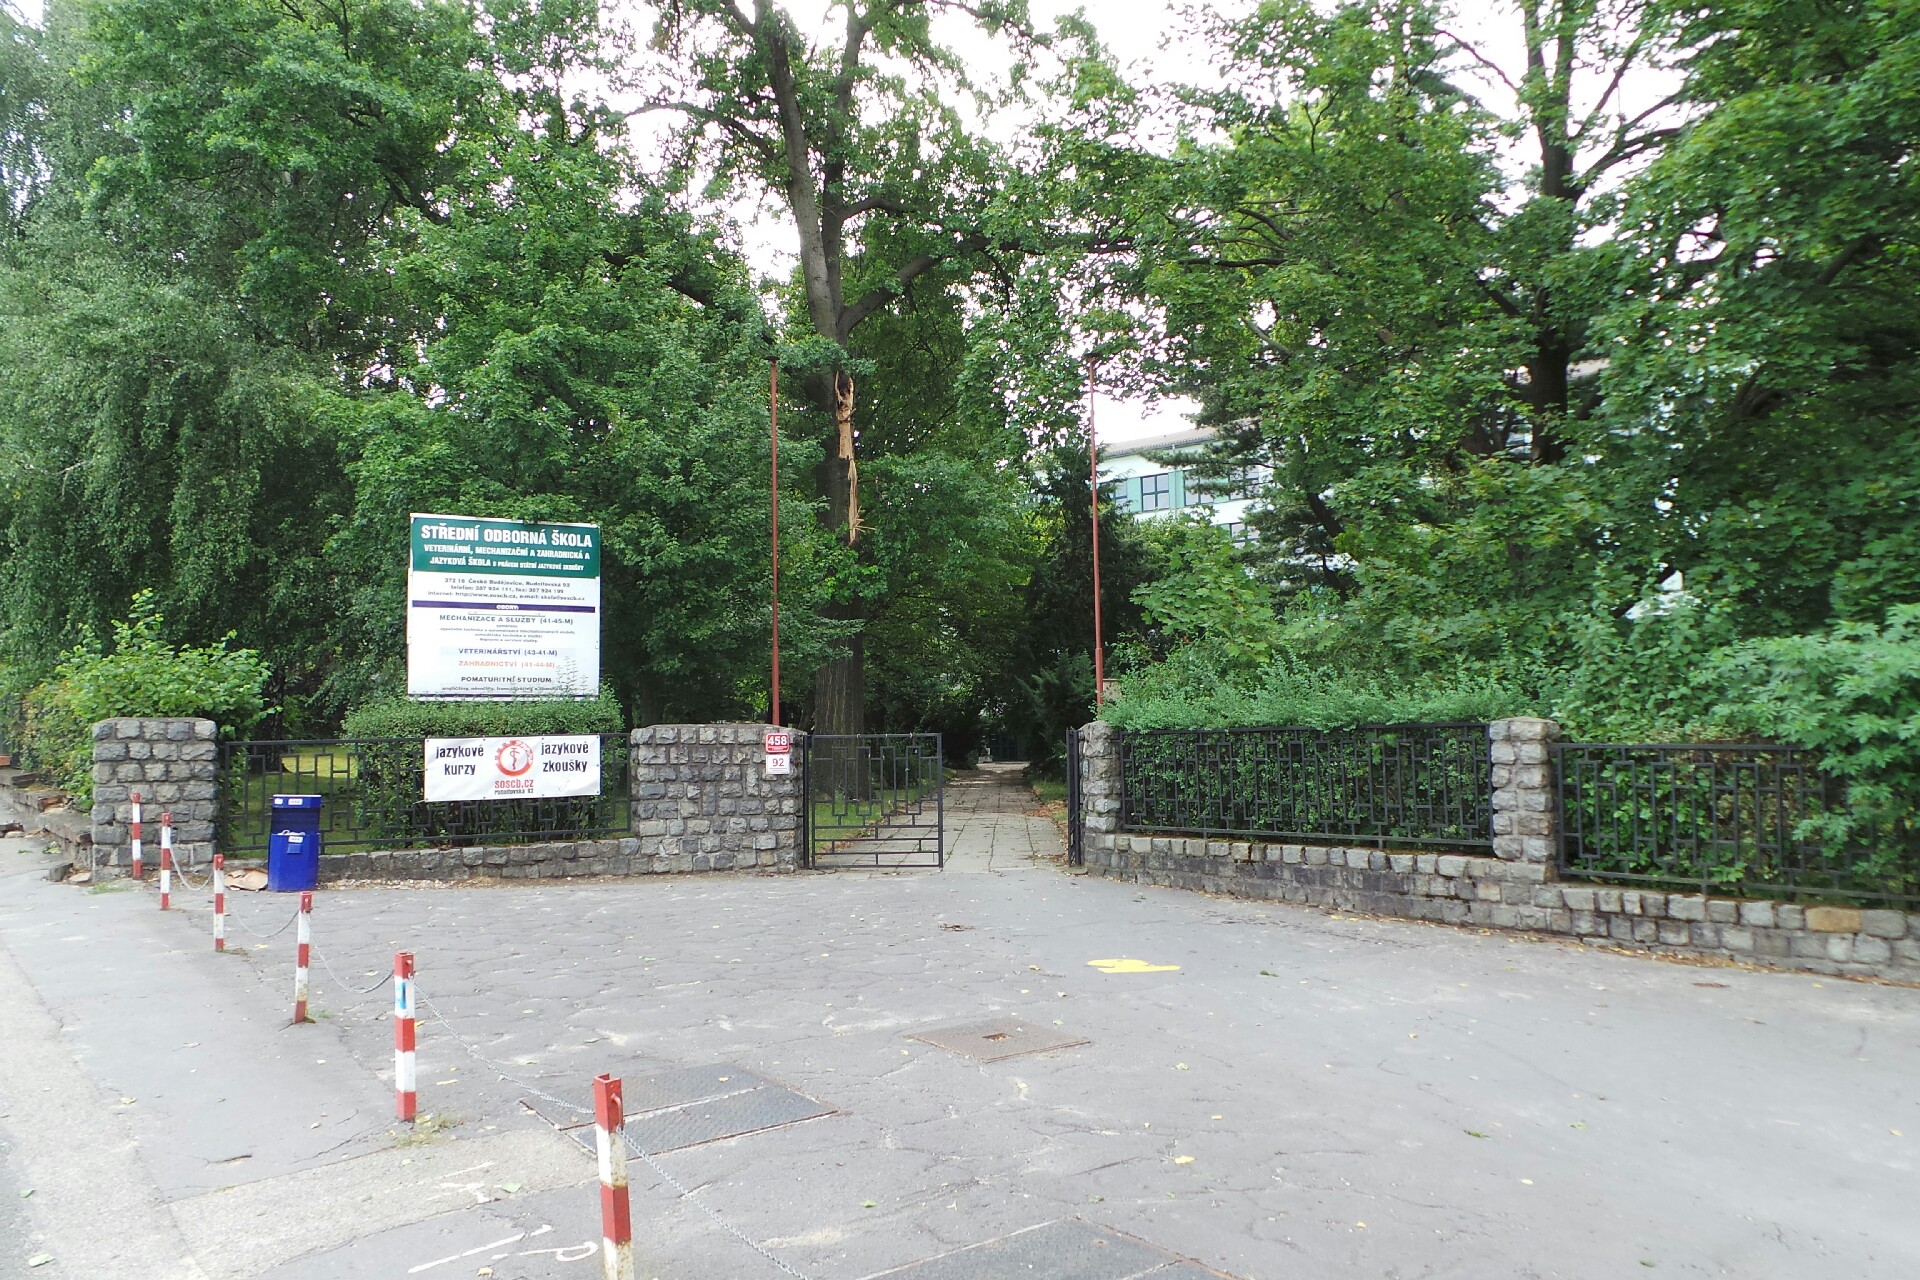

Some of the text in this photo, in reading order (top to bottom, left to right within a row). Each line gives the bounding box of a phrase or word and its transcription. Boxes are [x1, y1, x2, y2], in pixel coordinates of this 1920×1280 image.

[421, 522, 592, 547] STŘEDNÍ ODBORNÁ ŠKOLA
[424, 543, 590, 560] VETERINÁRNÍ, MECHANIZAČNÍ A ZAHRADNICKÁ A
[429, 556, 466, 565] JAZYKOVÁ
[468, 556, 491, 567] ŠKOLA
[439, 614, 496, 622] MECHANIZACE
[458, 659, 517, 667] ZAHRADNICTVÍ
[768, 735, 787, 746] 458
[435, 744, 484, 759] jazykové
[541, 741, 589, 756] jazykové
[542, 758, 588, 773] zkoušky
[772, 757, 785, 767] 92
[444, 763, 476, 776] kurzy
